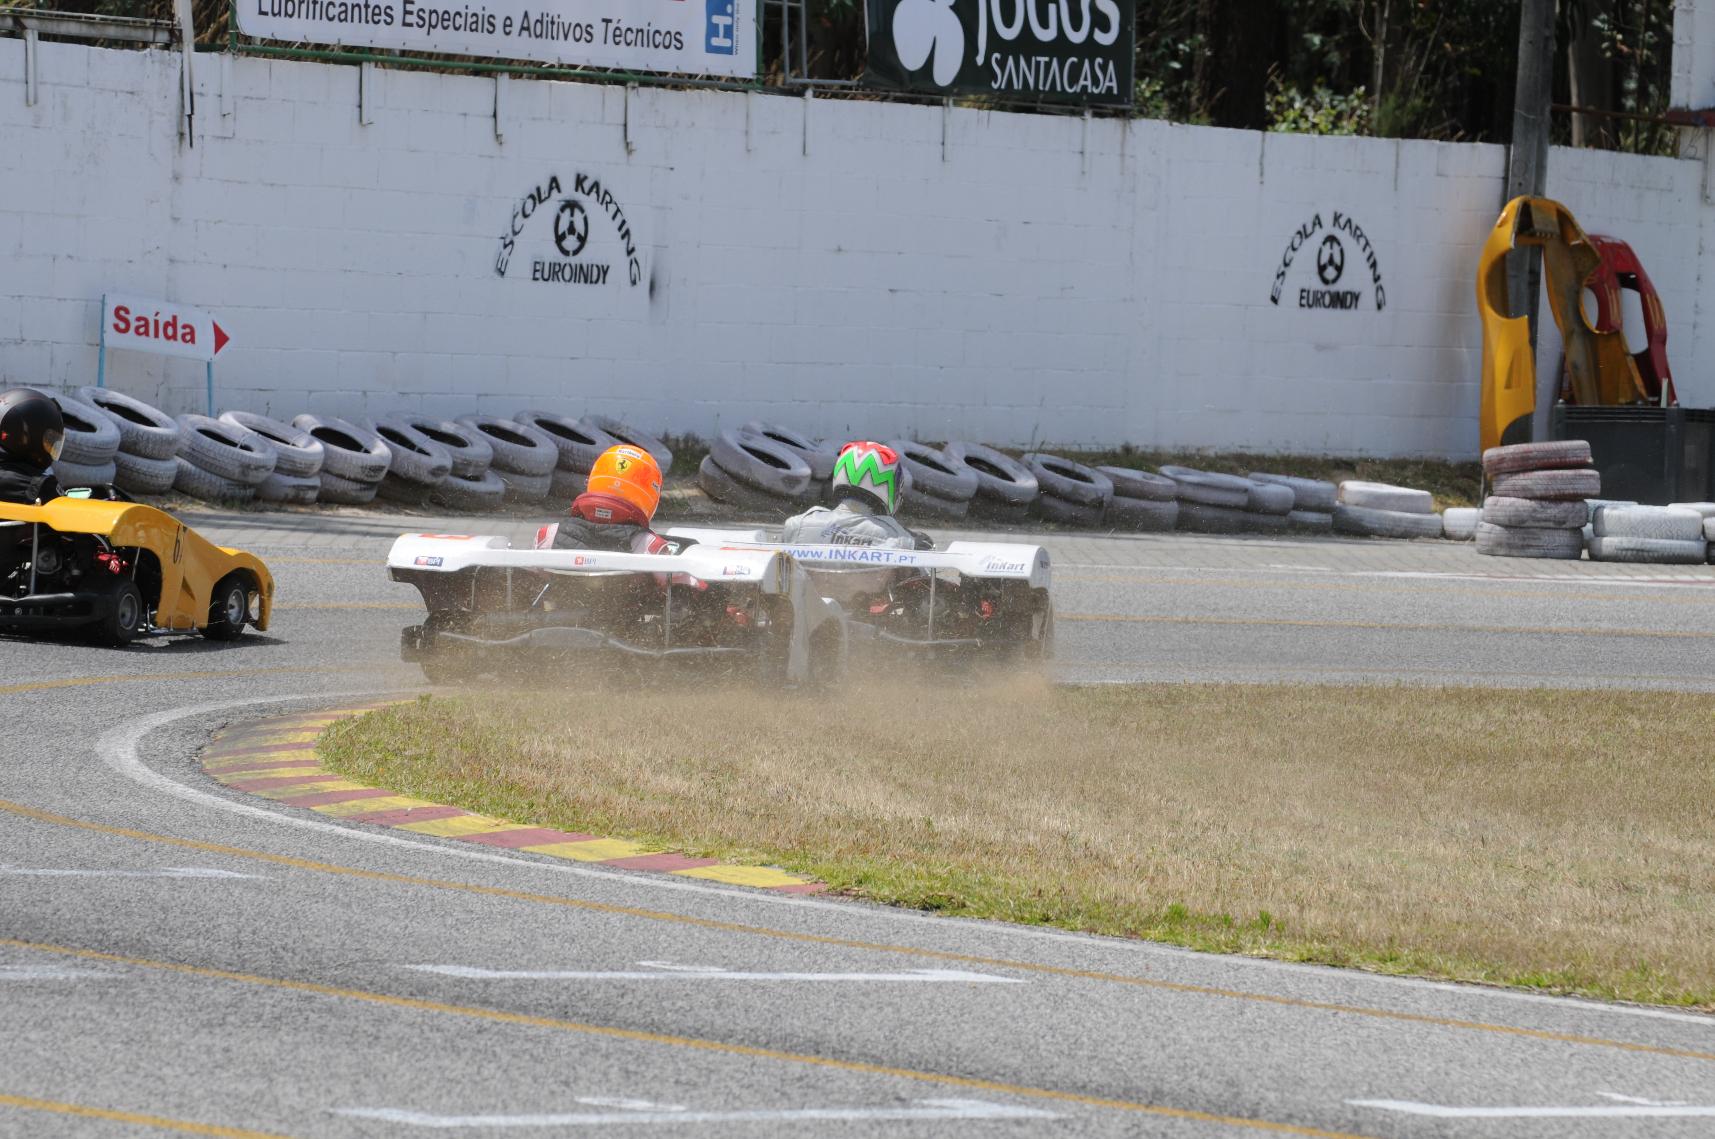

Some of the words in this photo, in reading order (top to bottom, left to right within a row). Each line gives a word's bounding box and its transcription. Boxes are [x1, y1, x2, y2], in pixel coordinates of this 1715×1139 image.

[257, 0, 394, 26] Lubrificantes
[401, 0, 496, 36] Especiais
[503, 15, 513, 36] e
[518, 10, 594, 44] Aditivos
[601, 18, 684, 50] Técnicos
[496, 175, 562, 277] ESCOLA
[574, 173, 641, 287] KARTING
[531, 261, 610, 285] EUROINDY
[1270, 213, 1323, 306] ESCOLA
[1332, 211, 1386, 312] KARTING
[1299, 288, 1361, 310] EUROINDY
[112, 304, 196, 345] Saída
